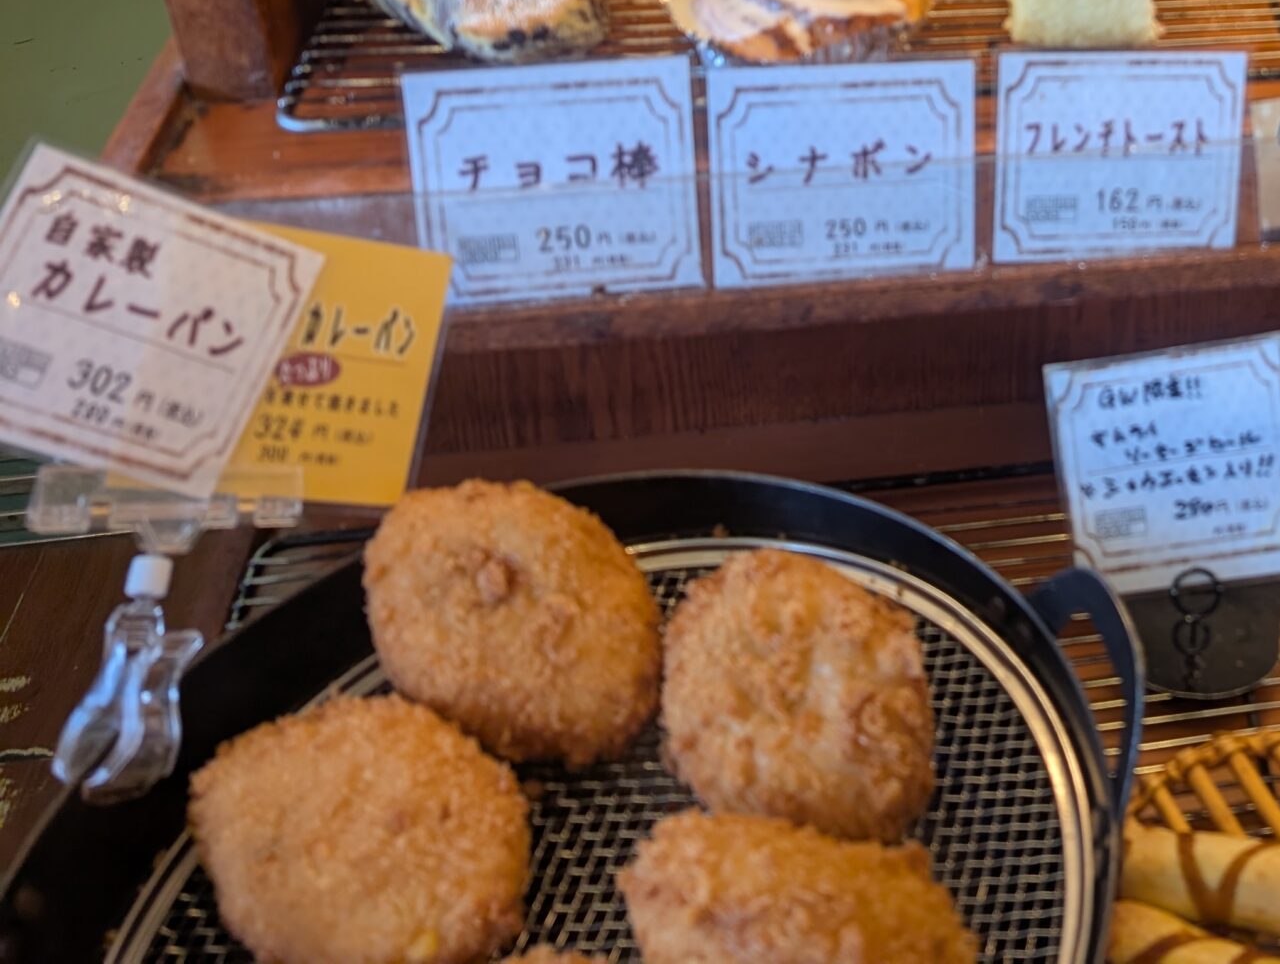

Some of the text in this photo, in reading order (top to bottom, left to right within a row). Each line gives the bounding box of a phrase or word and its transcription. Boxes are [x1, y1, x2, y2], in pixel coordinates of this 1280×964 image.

[1025, 117, 1209, 158] フレンチトースト
[458, 139, 660, 192] チョコ棒
[746, 138, 934, 185] シナボン
[1096, 187, 1140, 213] 162
[43, 210, 163, 279] 自家製
[535, 223, 593, 253] 250
[824, 217, 868, 241] 250
[31, 259, 244, 356] カレーパン
[67, 357, 134, 405] 302
